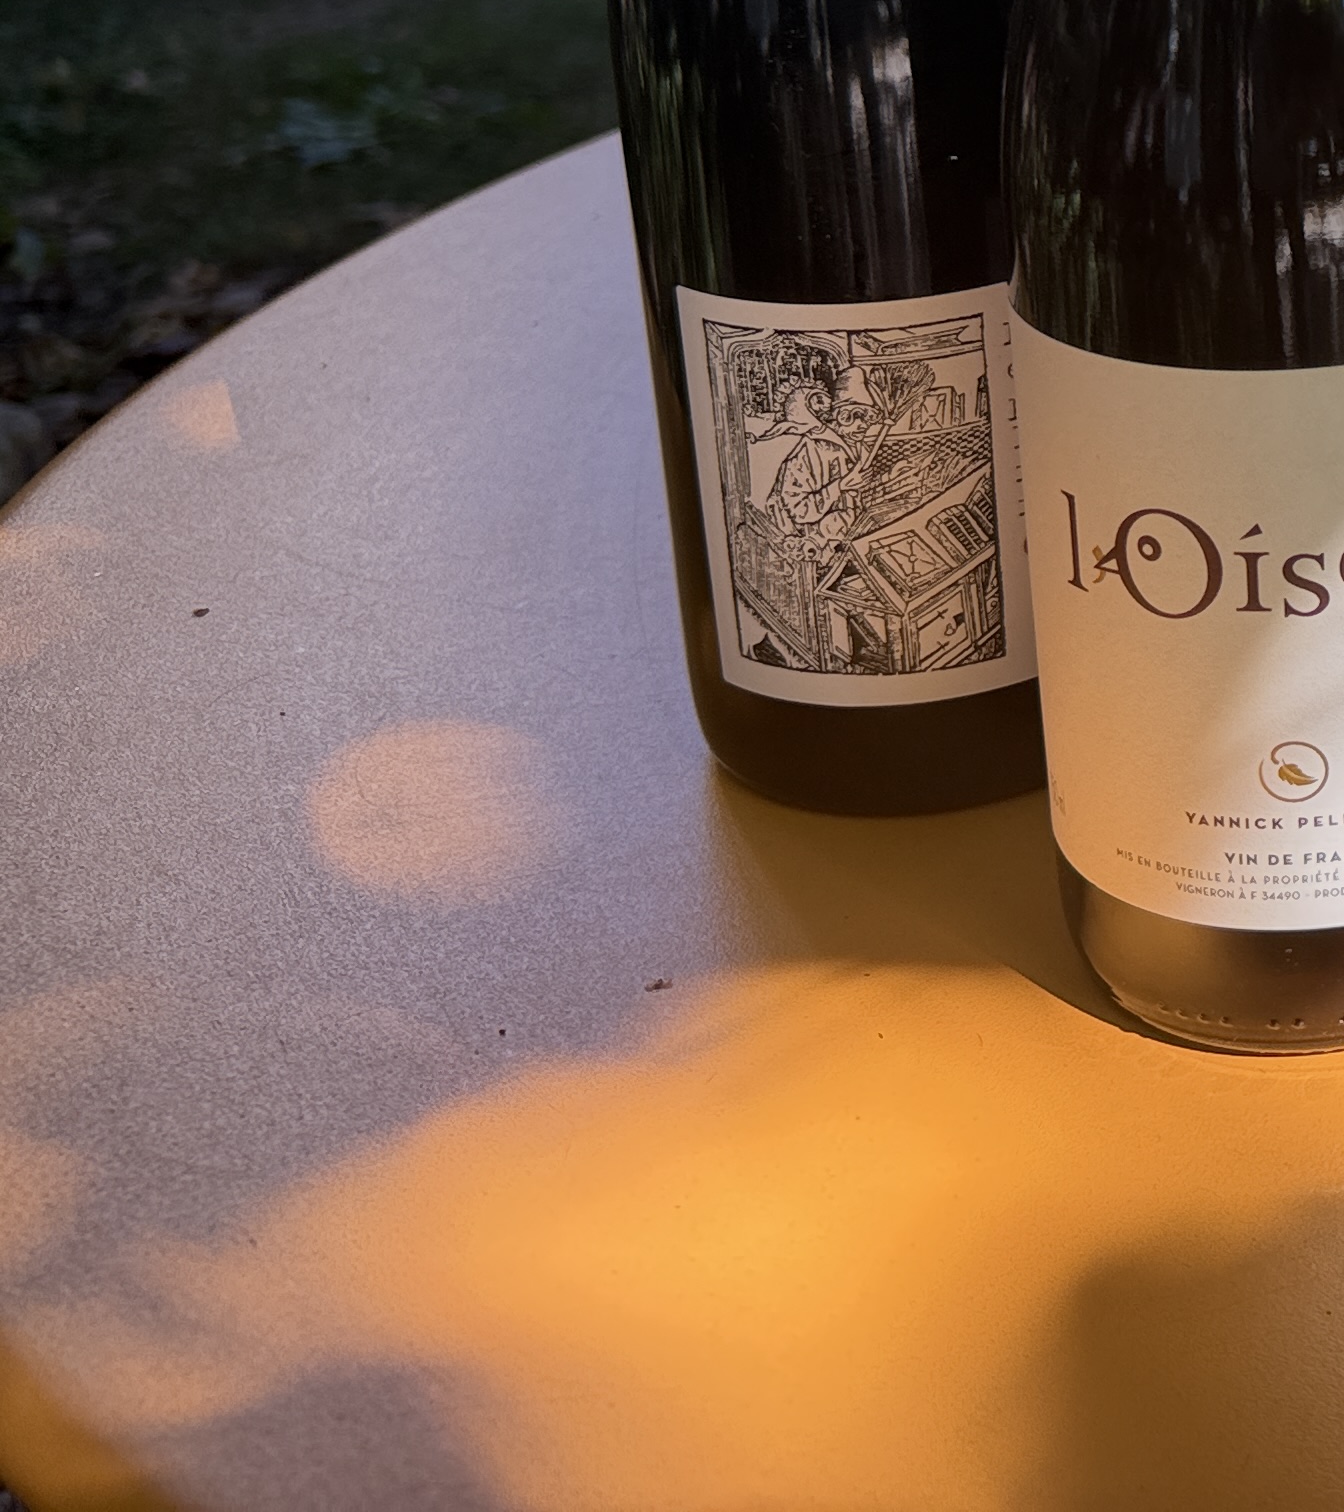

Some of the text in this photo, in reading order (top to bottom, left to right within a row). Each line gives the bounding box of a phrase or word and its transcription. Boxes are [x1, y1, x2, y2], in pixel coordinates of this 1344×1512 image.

[1185, 811, 1284, 830] YANNICK
[1116, 847, 1134, 862] MIS
[1137, 855, 1151, 868] EN
[1156, 861, 1221, 883] BOUTEILLE
[1228, 870, 1235, 884] À
[1241, 874, 1257, 885] LA
[1263, 868, 1340, 885] PROPRIÉTÉ
[1224, 852, 1258, 866] VIN
[1268, 853, 1293, 866] DE
[1176, 881, 1235, 899] VIGNERON
[1239, 887, 1247, 900] À
[1251, 891, 1258, 900] F
[1262, 890, 1301, 901] 34490
